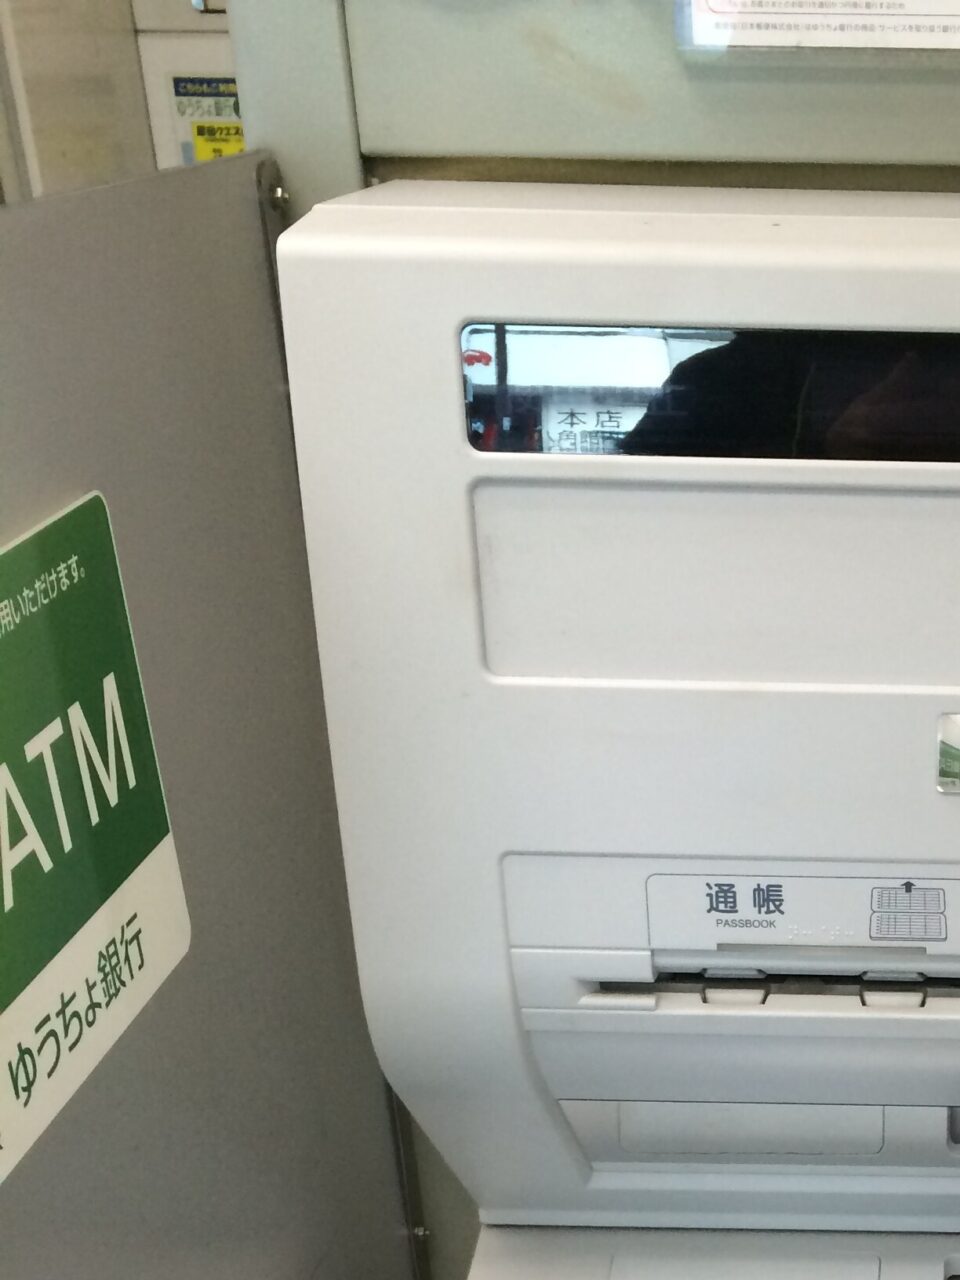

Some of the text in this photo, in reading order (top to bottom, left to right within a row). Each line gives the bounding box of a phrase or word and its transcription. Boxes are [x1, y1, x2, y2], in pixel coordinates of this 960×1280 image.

[0, 671, 137, 913] ATM
[706, 883, 785, 915] 通帳
[716, 919, 776, 929] PASSBOOK
[7, 911, 148, 1108] ゆうちょ銀行
